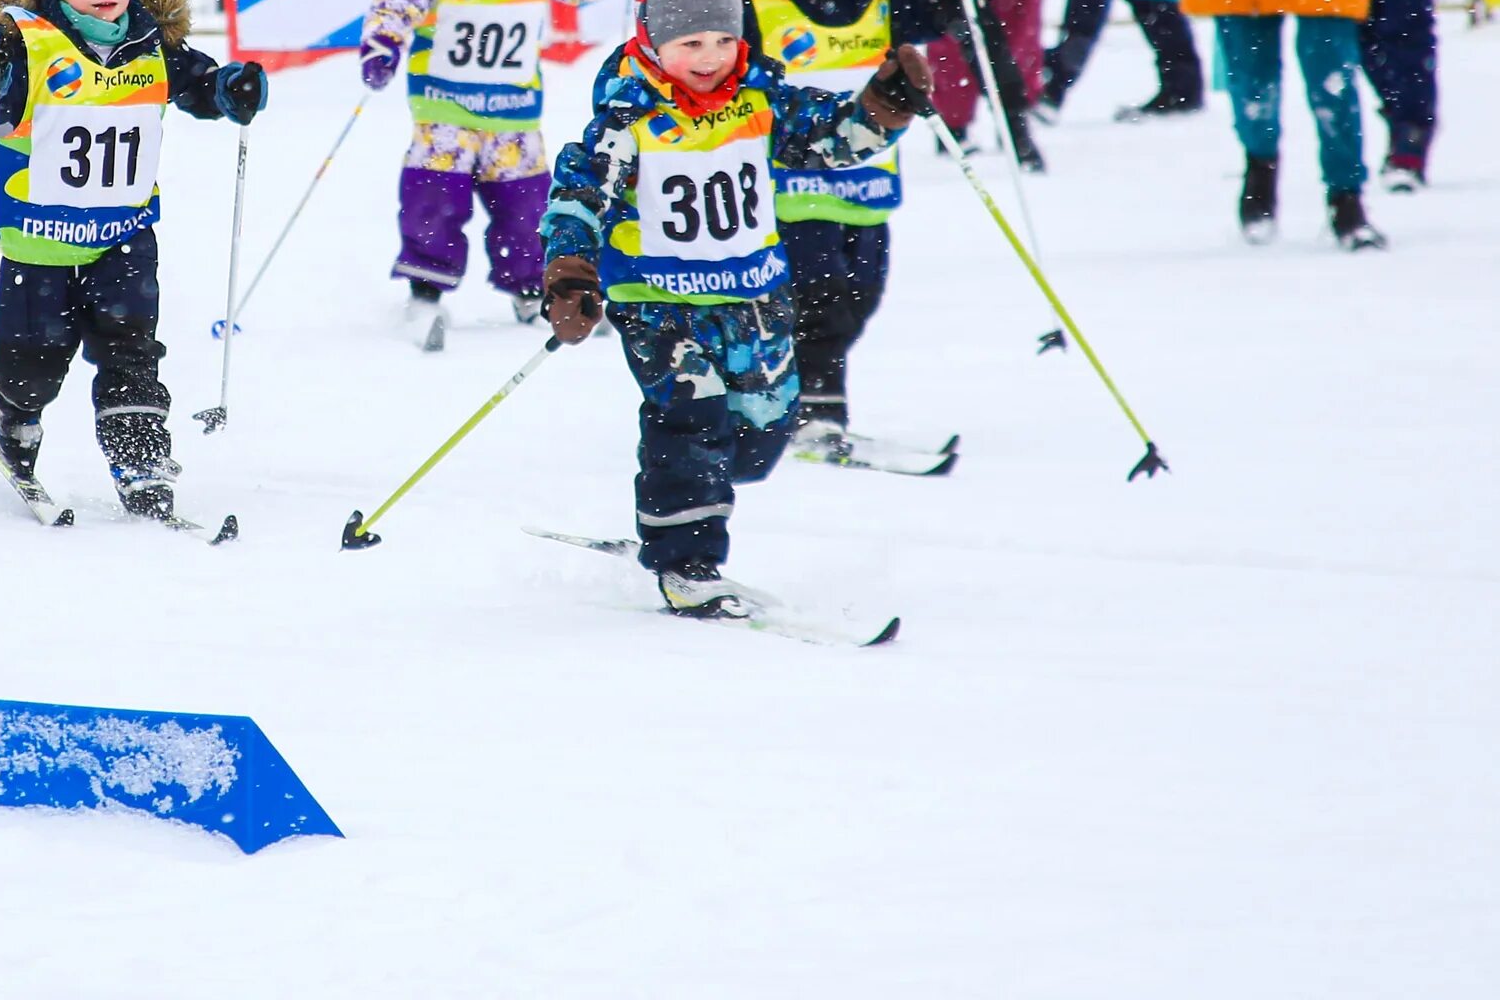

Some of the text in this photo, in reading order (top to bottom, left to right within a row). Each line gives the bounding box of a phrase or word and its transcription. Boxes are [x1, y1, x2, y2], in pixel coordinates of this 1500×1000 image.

[448, 21, 527, 69] 302
[94, 70, 155, 90] РусГидро
[60, 126, 141, 189] 311
[661, 162, 759, 243] 308
[22, 217, 98, 243] ГРЕБНОЙ
